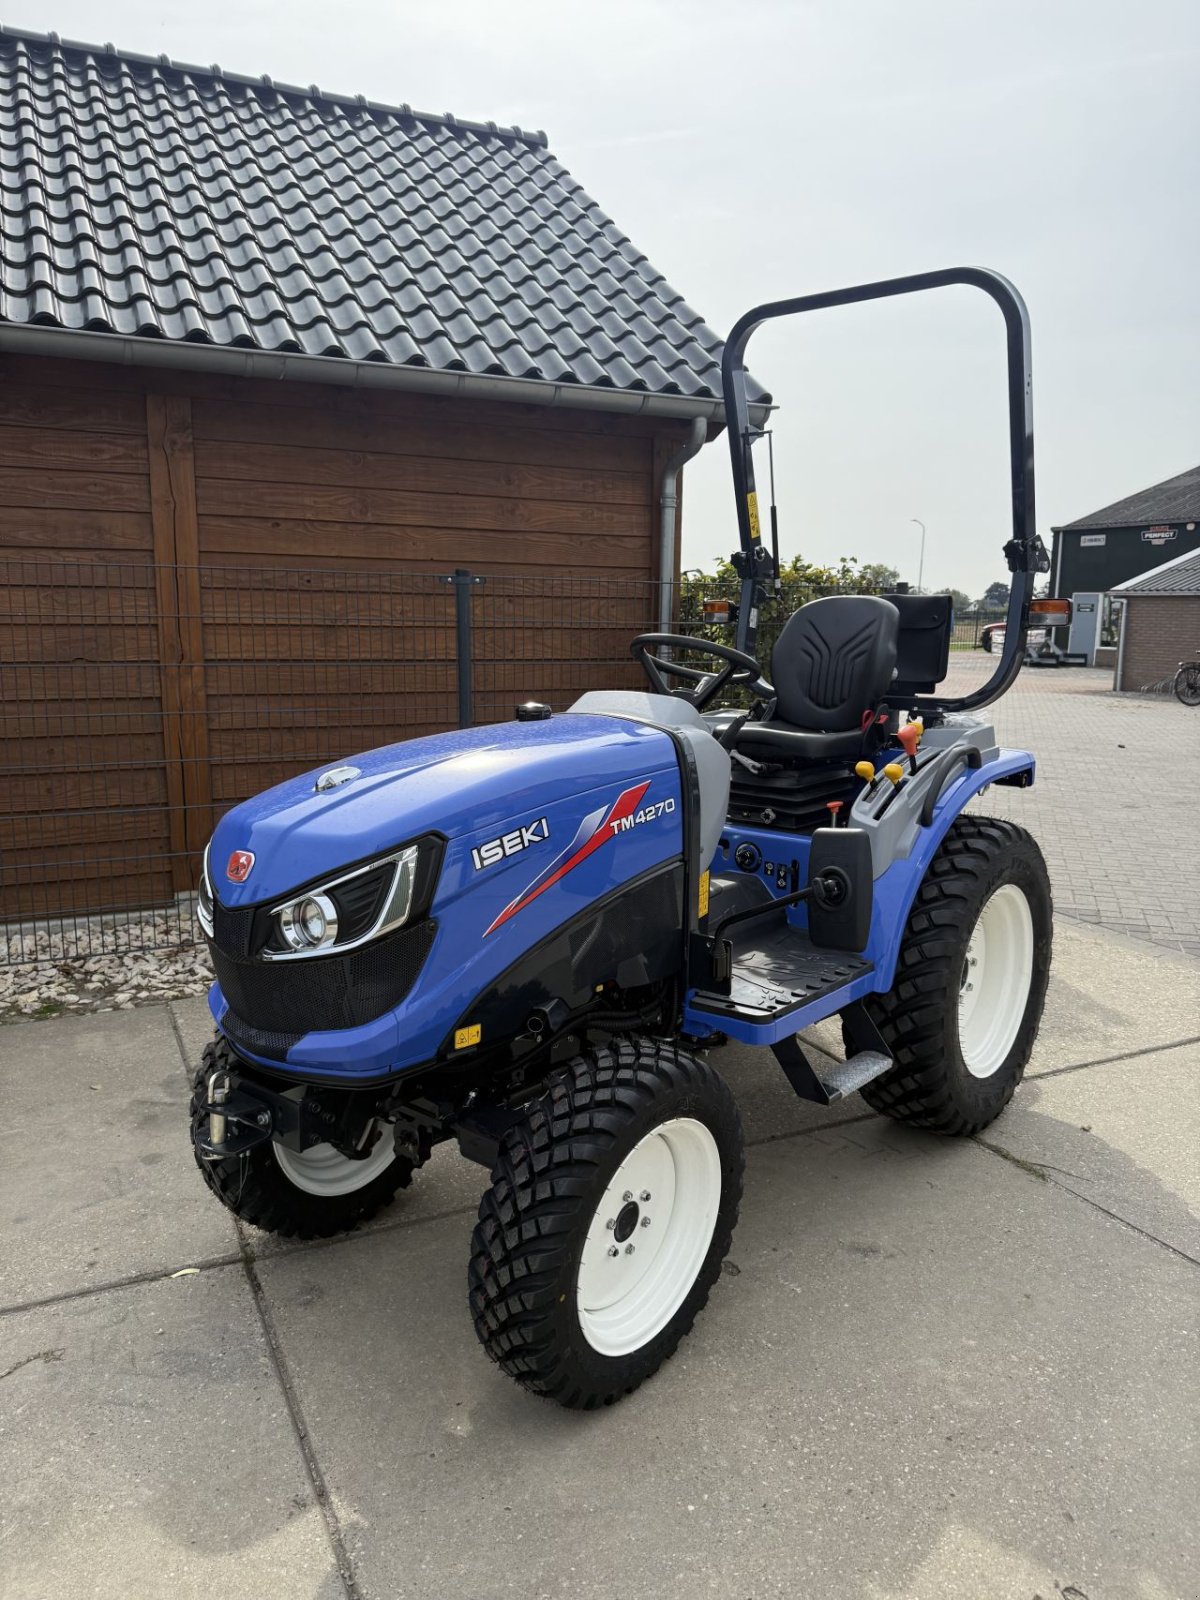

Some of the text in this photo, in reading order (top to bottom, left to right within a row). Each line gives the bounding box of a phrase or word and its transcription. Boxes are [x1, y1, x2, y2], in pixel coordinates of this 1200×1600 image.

[1144, 531, 1174, 539] PERFECT
[610, 798, 676, 835] TM4270
[471, 817, 550, 870] ISEKI
